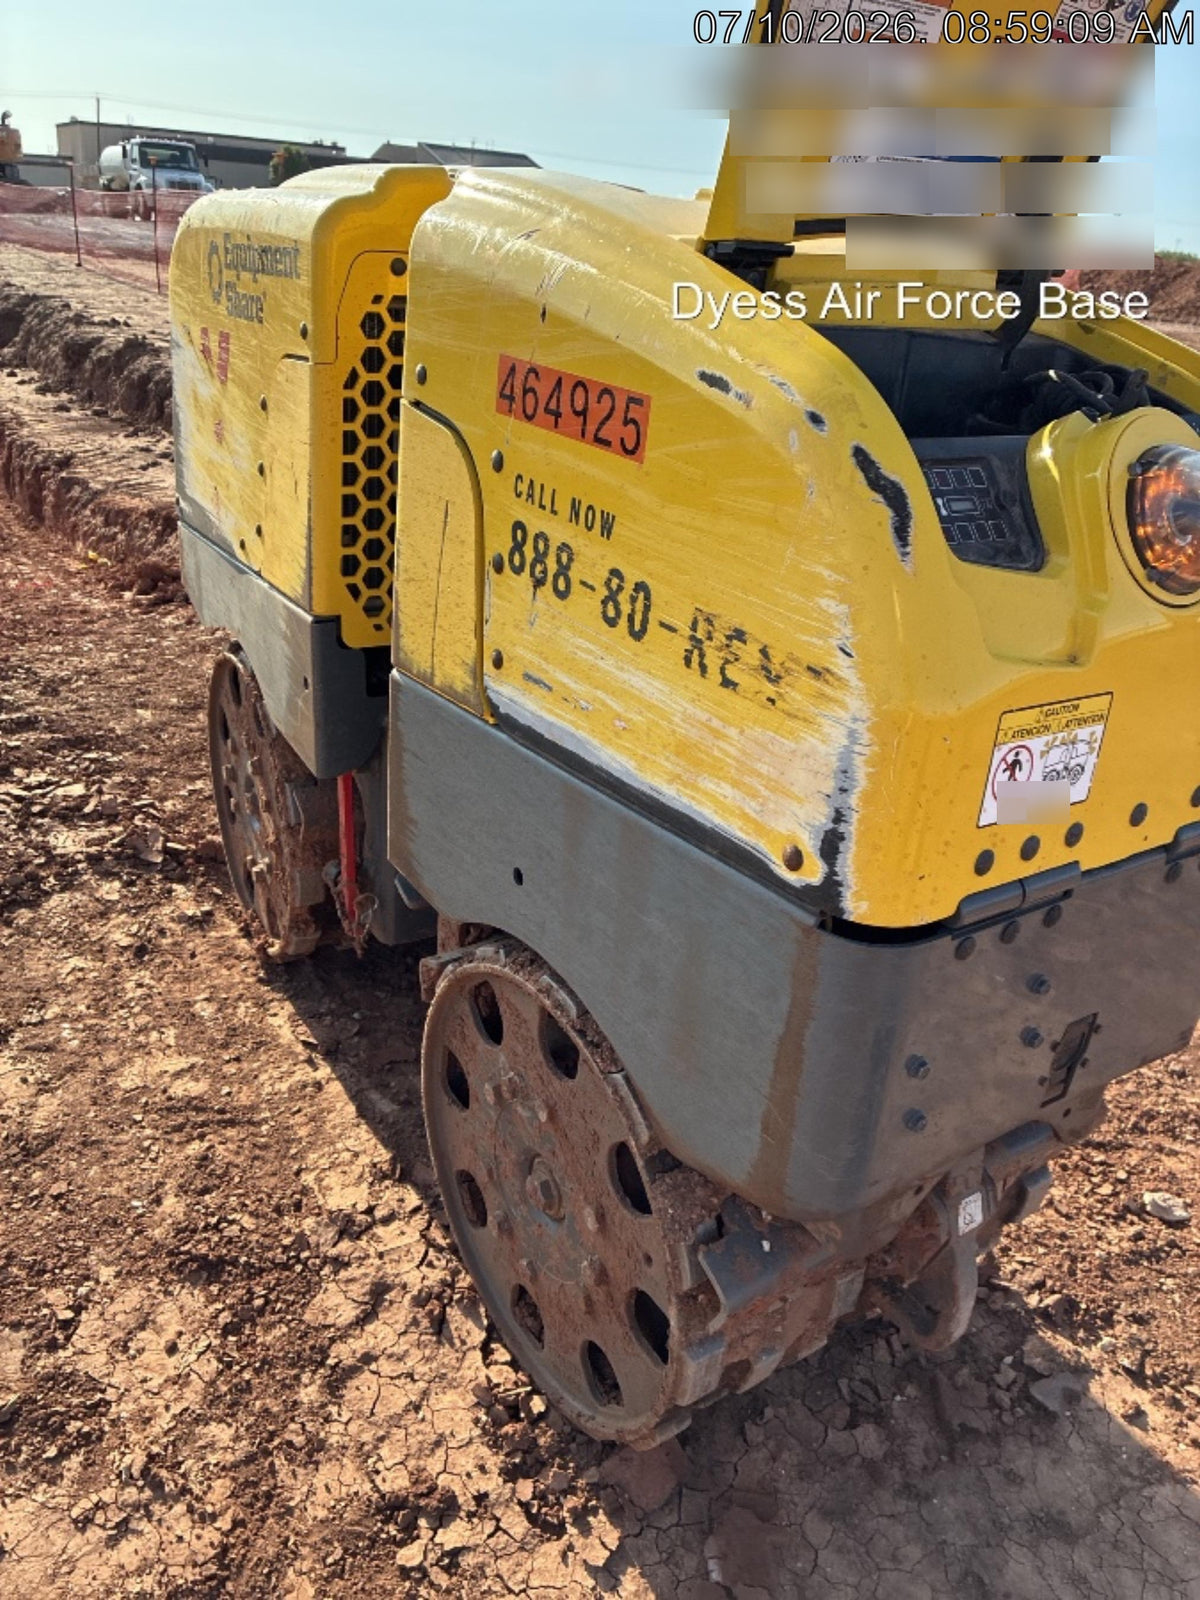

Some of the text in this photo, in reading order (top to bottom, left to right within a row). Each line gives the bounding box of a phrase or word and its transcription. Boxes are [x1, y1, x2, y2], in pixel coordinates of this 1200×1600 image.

[223, 232, 300, 283] Equipment
[499, 362, 644, 456] 464925
[513, 473, 616, 541] CALL NOW
[1045, 703, 1079, 719] CAUTION
